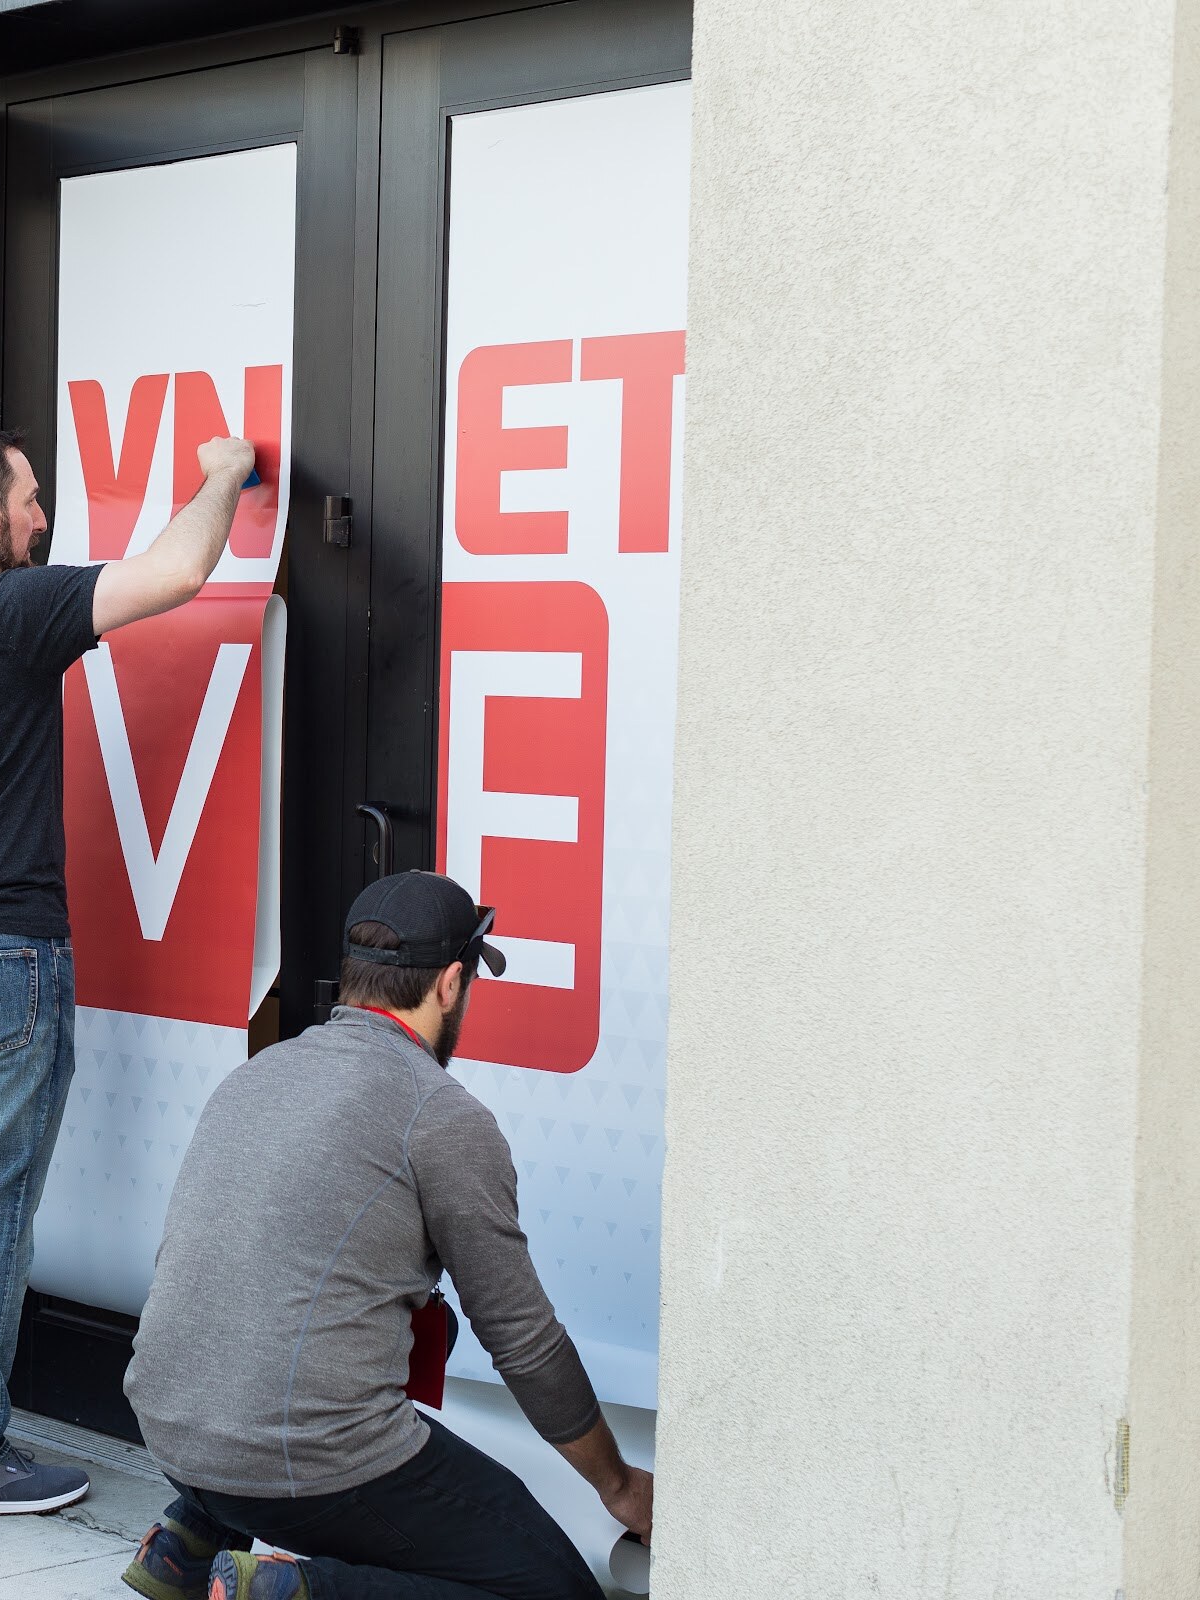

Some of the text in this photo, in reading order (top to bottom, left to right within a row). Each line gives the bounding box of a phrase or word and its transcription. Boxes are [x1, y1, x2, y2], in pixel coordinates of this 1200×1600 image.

[455, 329, 686, 555] ET
[82, 643, 582, 990] V E
